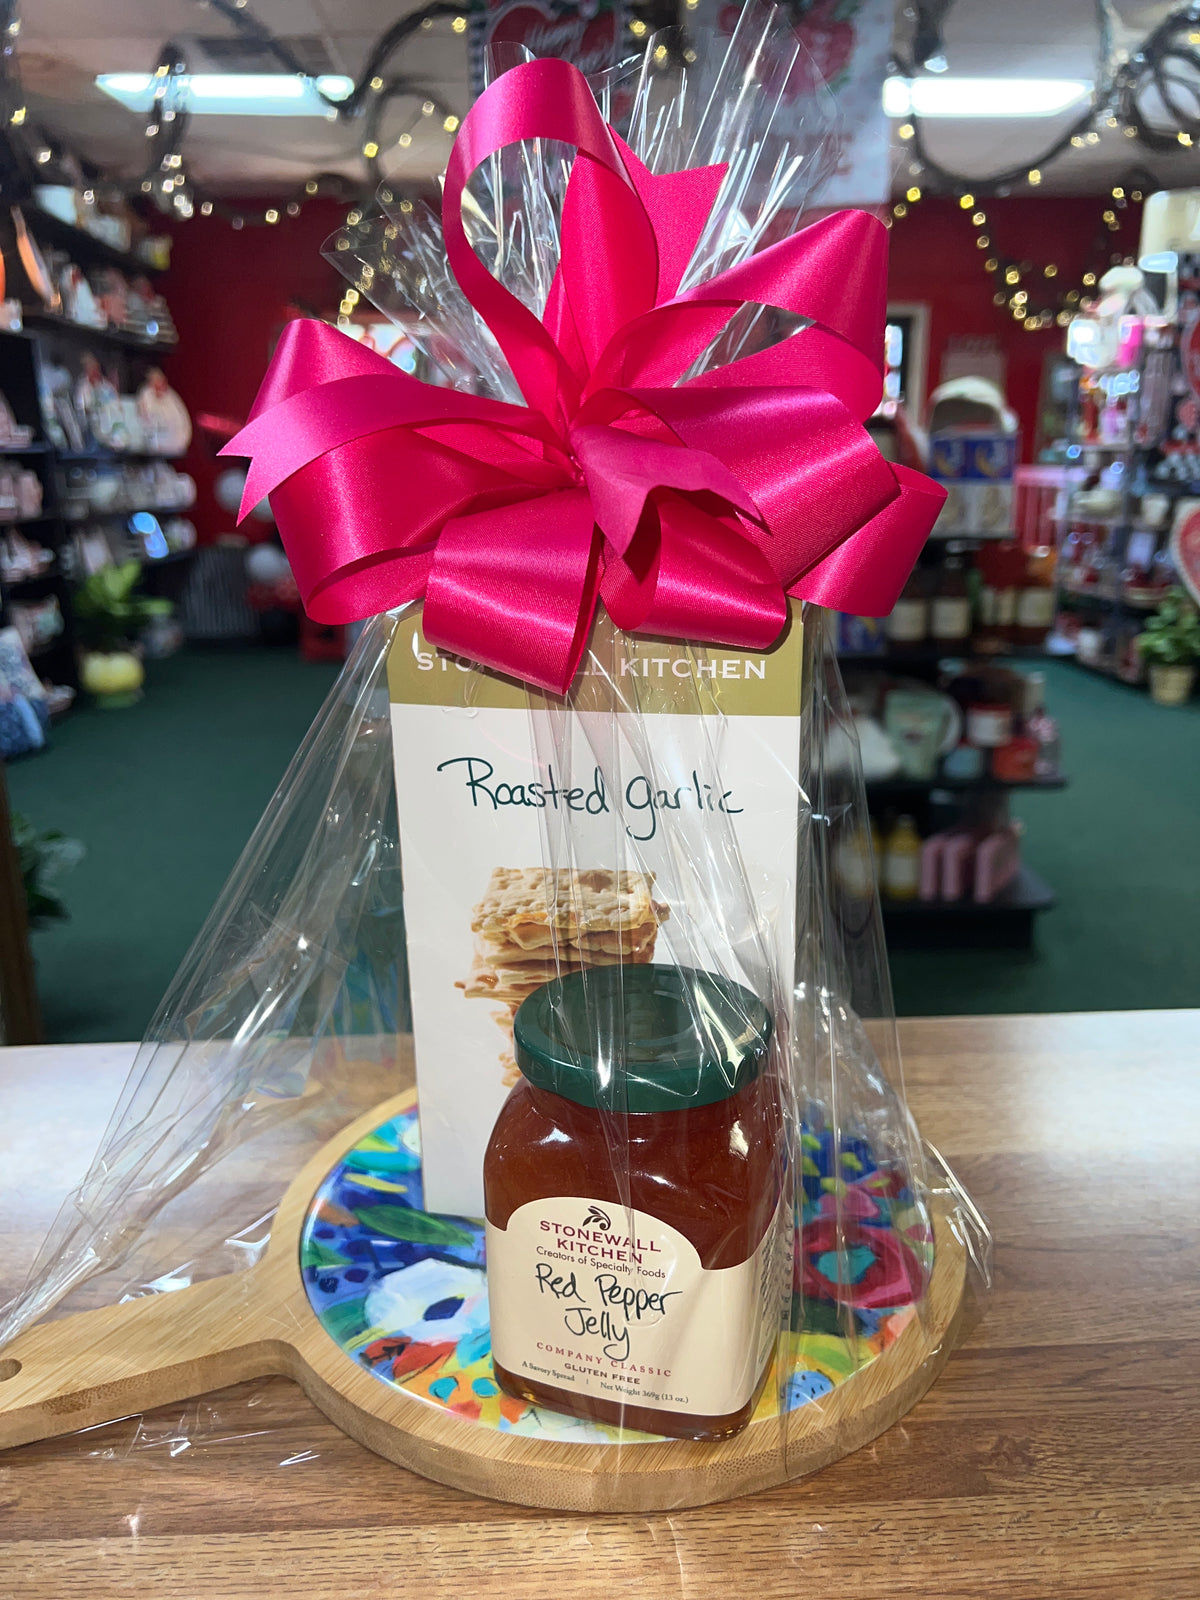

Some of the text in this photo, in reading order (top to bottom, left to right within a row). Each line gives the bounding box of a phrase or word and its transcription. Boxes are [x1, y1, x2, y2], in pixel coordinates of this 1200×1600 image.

[619, 656, 766, 680] KITCHEN
[437, 756, 609, 815] Roasted
[540, 1220, 661, 1253] STONEWALL
[557, 1238, 643, 1265] KITCHEN
[536, 1246, 666, 1279] Creators of Specialty Foods
[535, 1262, 683, 1322] Red Pepper
[564, 1307, 630, 1362] Jelly
[536, 1341, 672, 1378] COMPANY CLASSIC
[564, 1362, 641, 1385] GLUTEN FREE
[529, 1362, 551, 1376] Savory
[552, 1369, 575, 1382] Spread
[600, 1381, 613, 1391] Net
[615, 1384, 641, 1396] Weight
